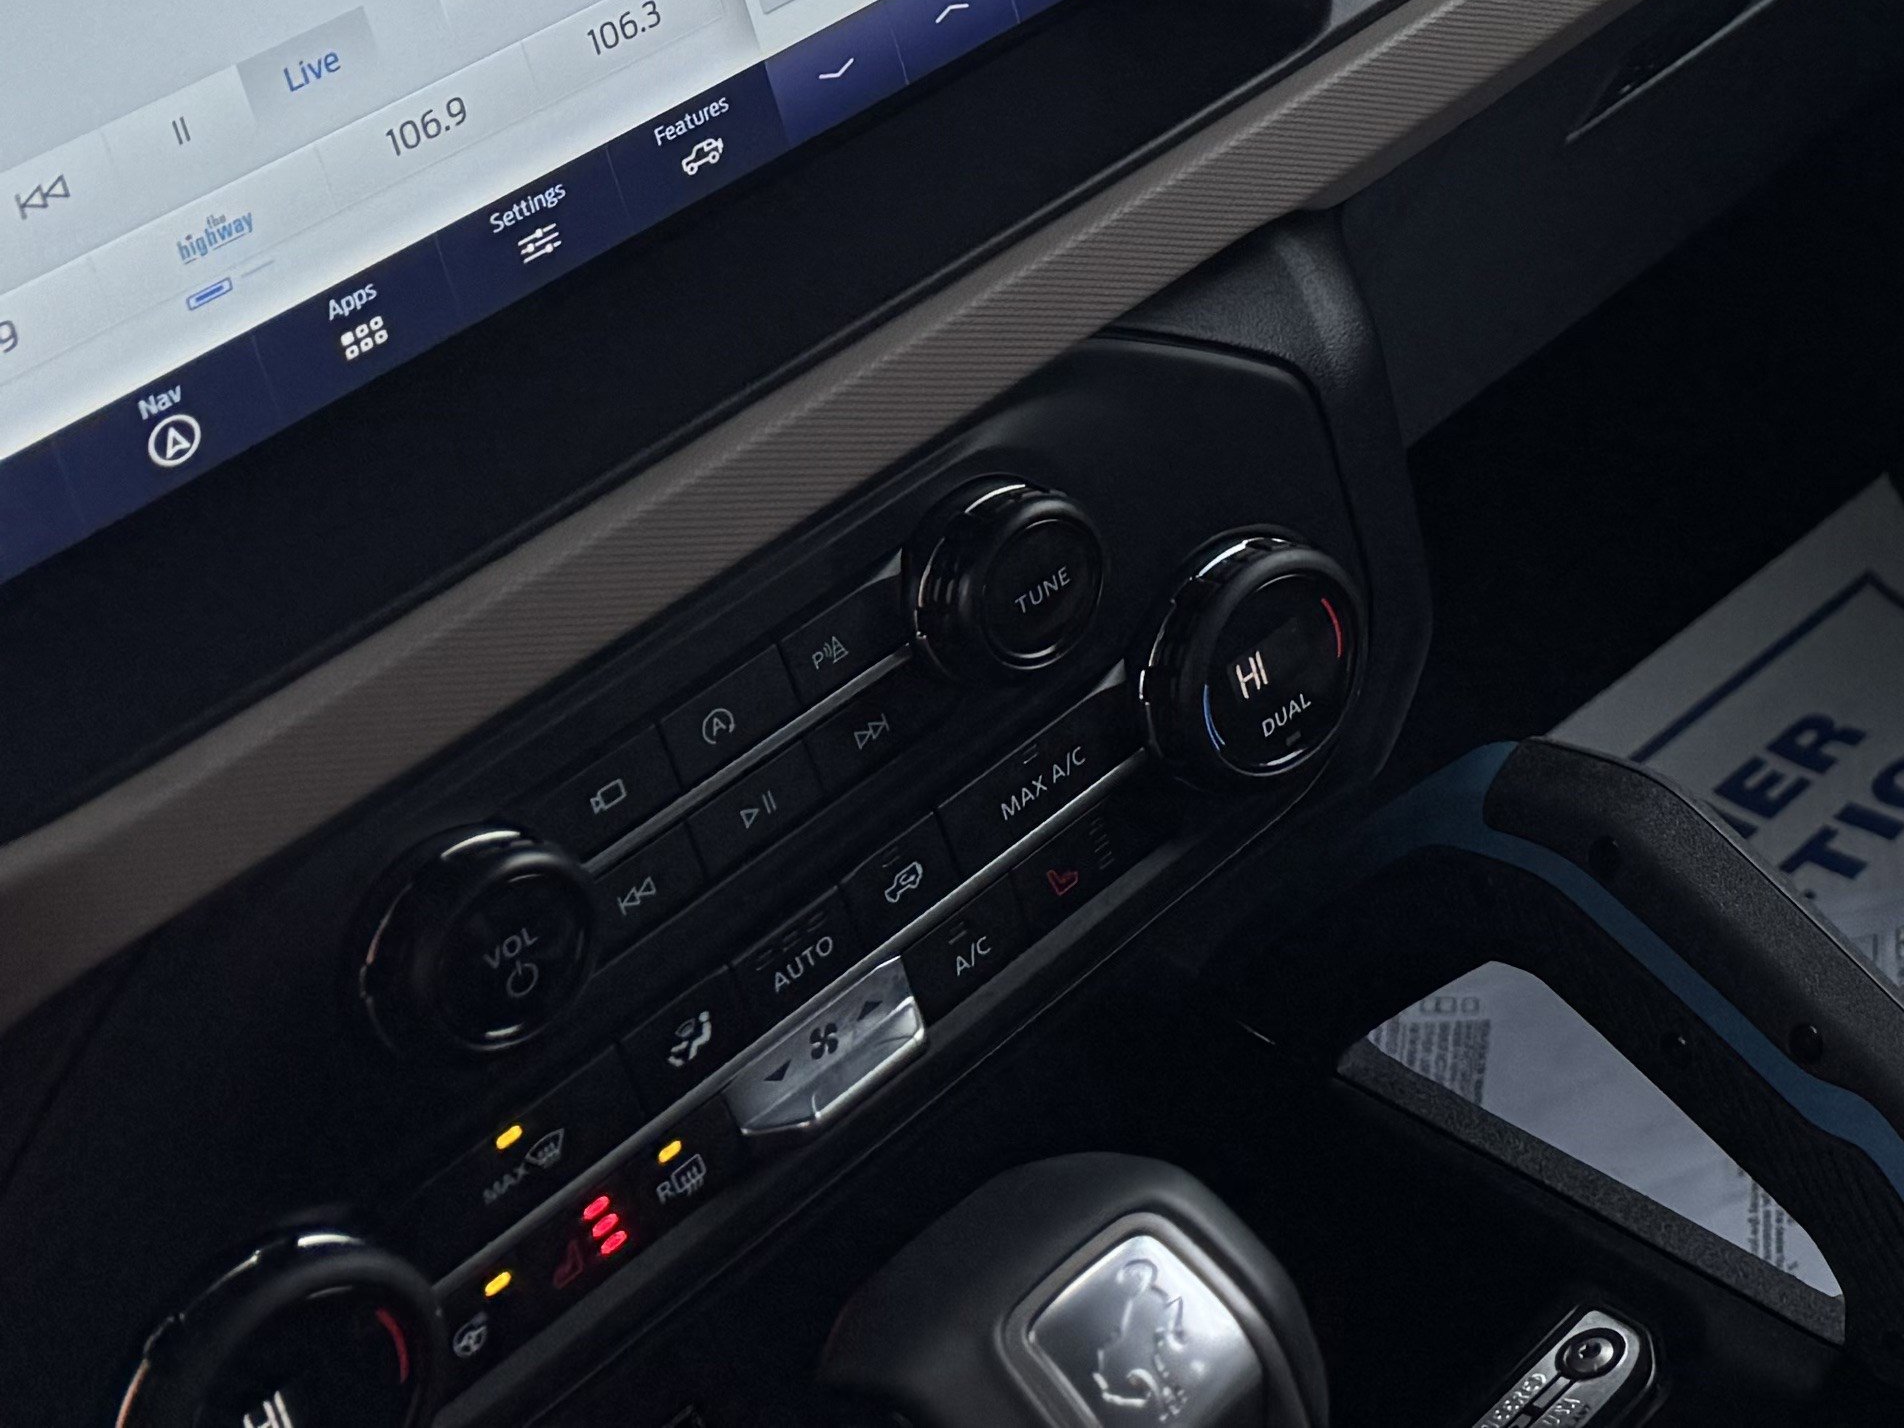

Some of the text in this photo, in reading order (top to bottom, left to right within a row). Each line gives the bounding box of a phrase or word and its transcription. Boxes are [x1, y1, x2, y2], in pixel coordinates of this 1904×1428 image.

[586, 0, 662, 57] 106.3
[283, 48, 342, 94] Live
[385, 95, 468, 157] 106.9
[653, 94, 730, 148] Features
[489, 180, 568, 235] Settings
[176, 211, 254, 261] highway
[327, 281, 378, 322] Apps
[137, 384, 183, 421] Nav
[1014, 562, 1073, 616] TUNE
[1234, 652, 1268, 700] HI
[1259, 692, 1313, 739] DUAL
[1001, 746, 1087, 821] MAX A/C
[481, 925, 539, 972] VOL
[770, 934, 835, 995] AUTO
[952, 934, 993, 978] A/C
[482, 1160, 531, 1206] MAX
